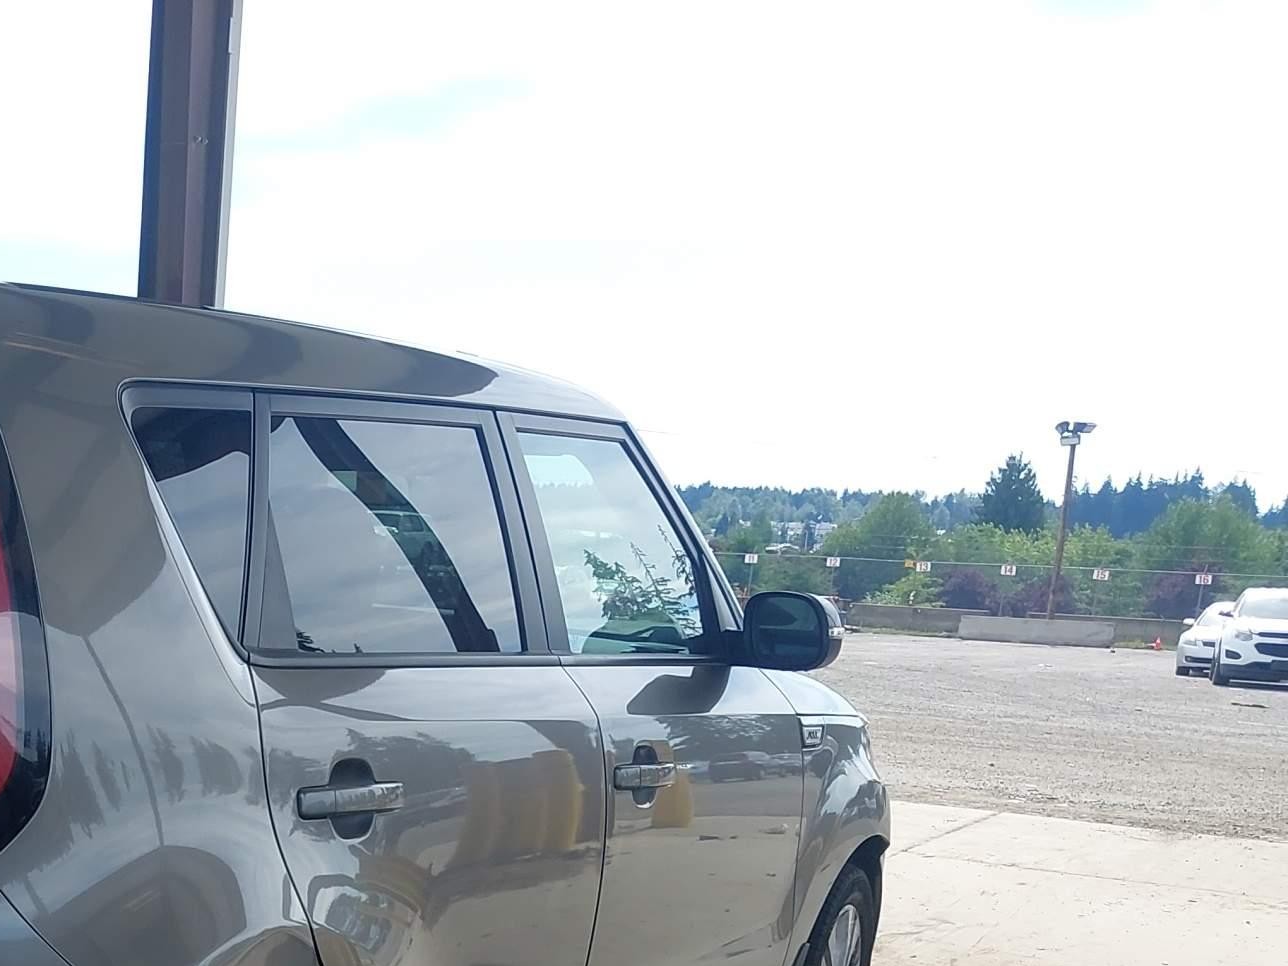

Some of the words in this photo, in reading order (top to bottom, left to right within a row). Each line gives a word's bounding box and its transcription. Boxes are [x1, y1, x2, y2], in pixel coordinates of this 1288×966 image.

[828, 557, 838, 566] 12
[919, 562, 929, 571] 13
[1003, 565, 1013, 575] 14
[1096, 570, 1106, 580] 15
[1199, 575, 1210, 584] 16
